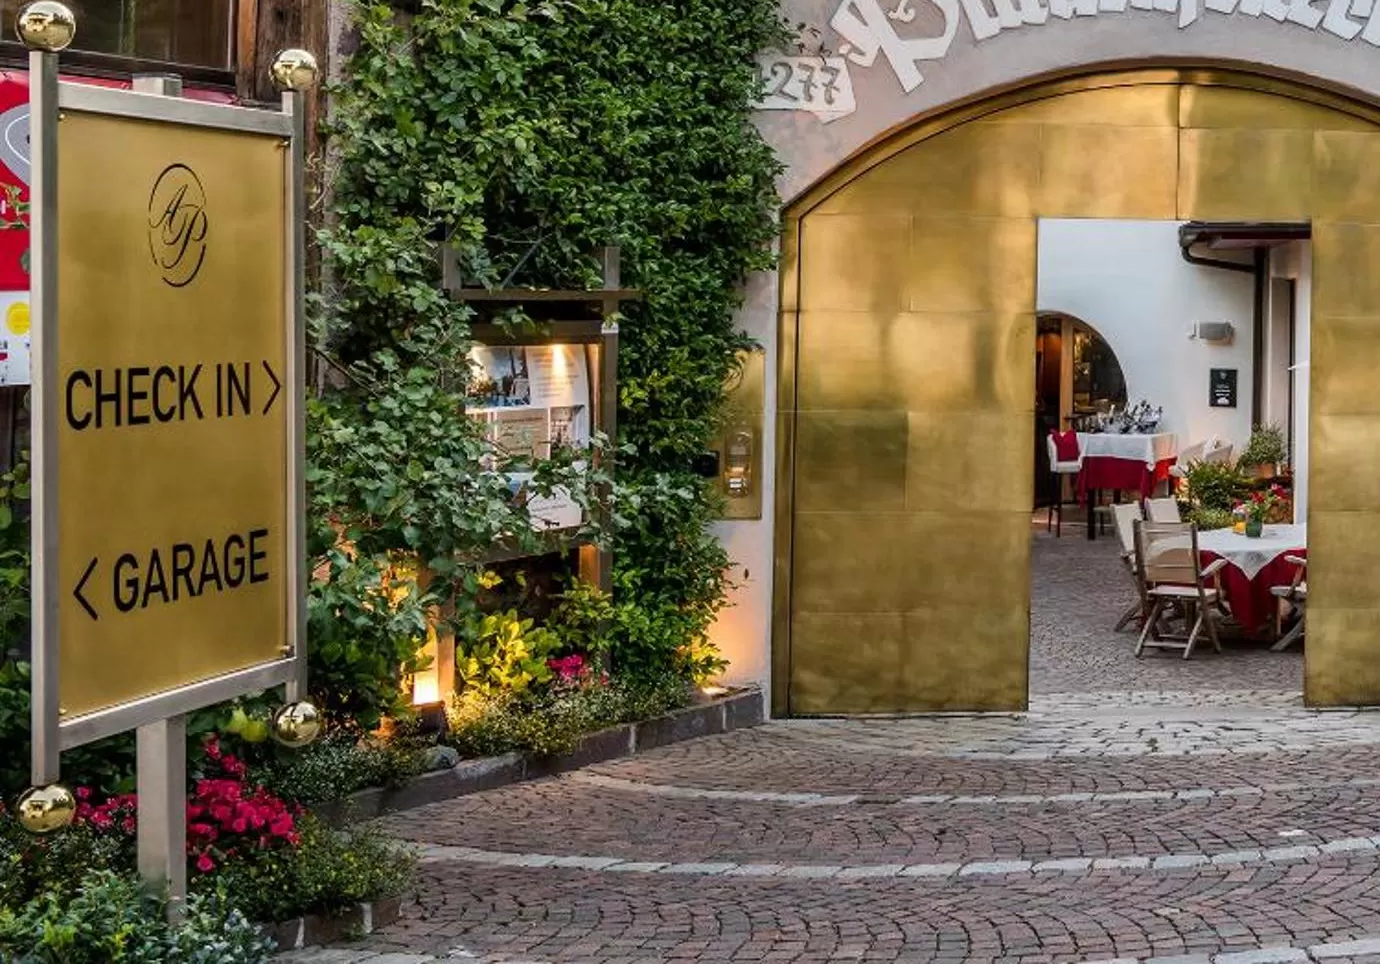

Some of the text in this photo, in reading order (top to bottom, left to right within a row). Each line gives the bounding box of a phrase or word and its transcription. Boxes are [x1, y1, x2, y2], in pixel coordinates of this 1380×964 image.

[760, 61, 841, 105] 277
[66, 361, 251, 430] CHECK IN
[113, 528, 269, 613] GARAGE
